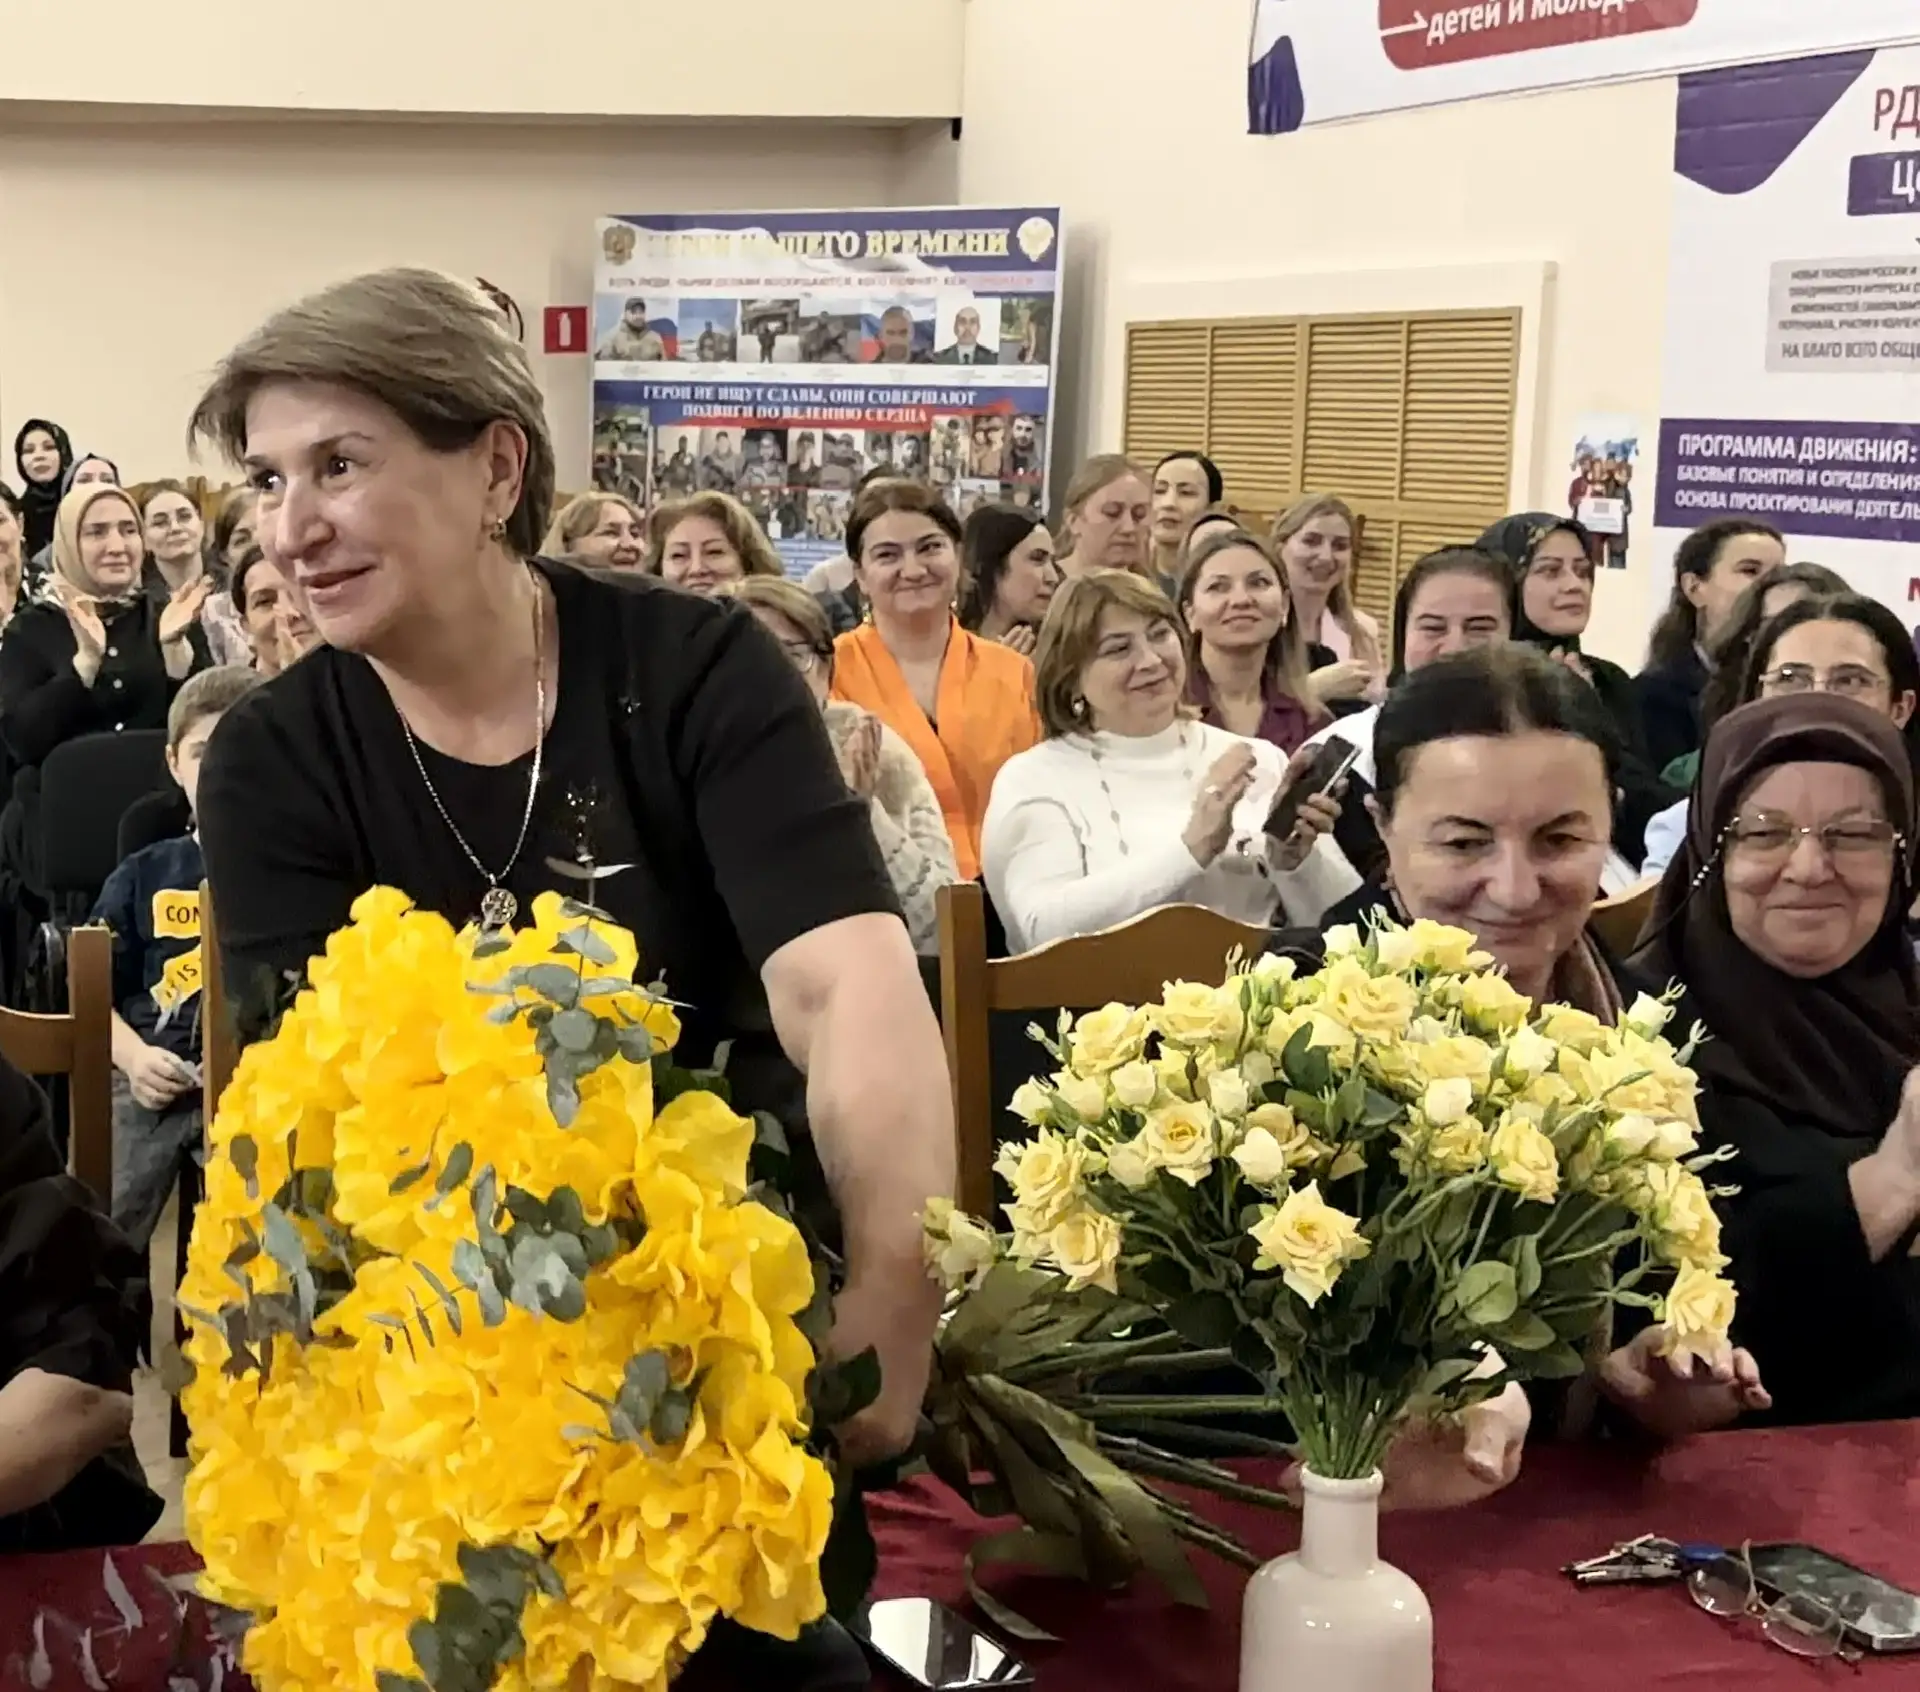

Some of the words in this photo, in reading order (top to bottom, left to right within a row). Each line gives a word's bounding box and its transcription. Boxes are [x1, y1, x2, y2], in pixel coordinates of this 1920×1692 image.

[1426, 0, 1500, 46] детей
[1892, 159, 1920, 203] Ц
[865, 228, 1011, 258] ВРЕМЕНИ
[1782, 342, 1800, 358] НА
[643, 385, 691, 400] ГЕРОИ
[694, 386, 715, 400] НЕ
[868, 389, 978, 405] СОВЕРШАЮТ
[865, 407, 927, 423] СЕРДЦА
[1677, 433, 1796, 460] ПРОГРАММА
[1798, 436, 1919, 464] ДВИЖЕНИЯ:
[1676, 464, 1737, 483] БАЗОВЫЕ
[1738, 467, 1804, 486] ПОНЯТИЯ
[1806, 469, 1818, 486] И
[1674, 490, 1727, 509] ОСНОВА
[1729, 492, 1854, 515] ПРОЕКТИРОВАНИЯ
